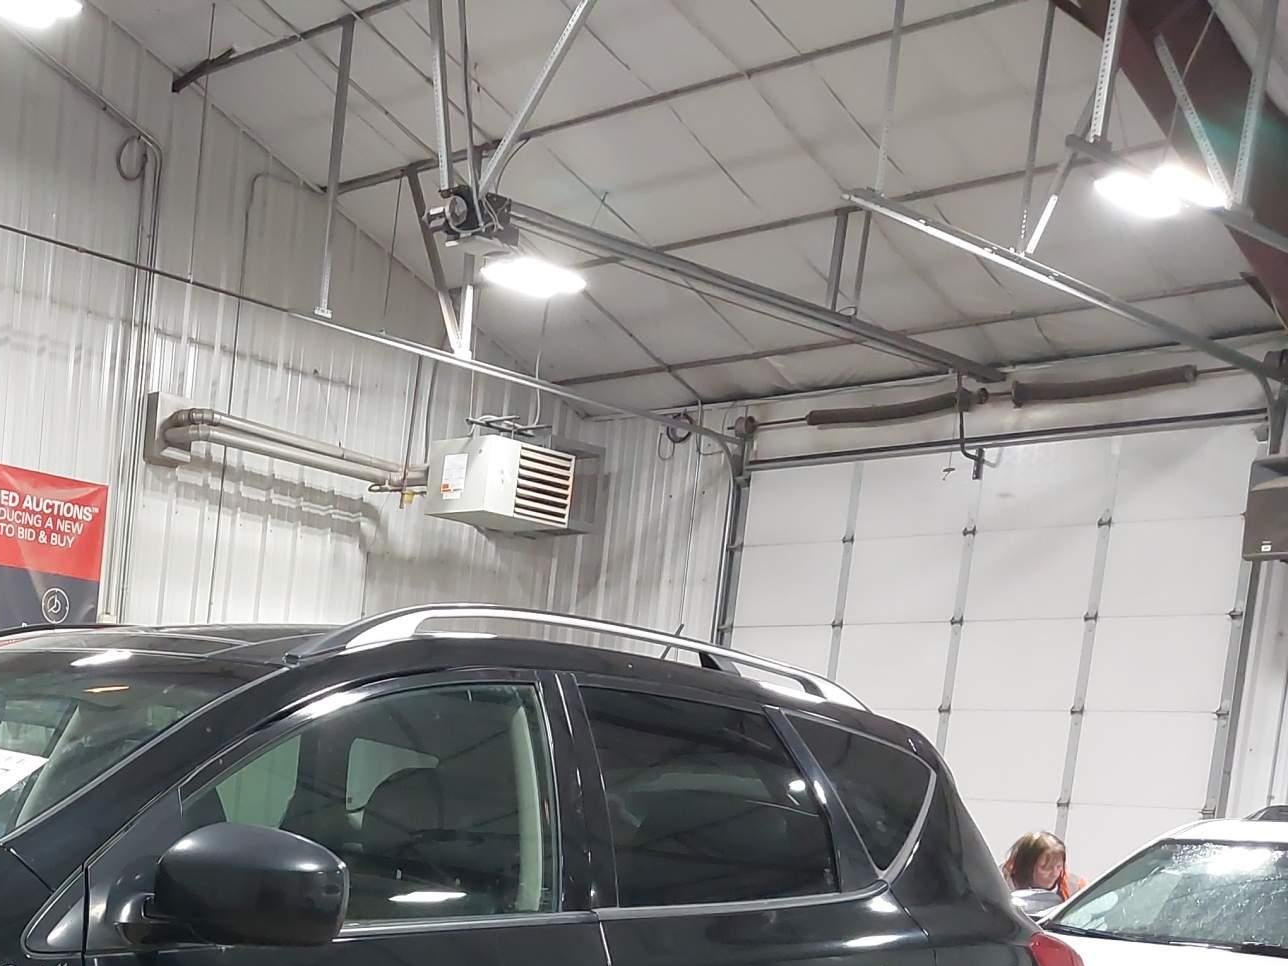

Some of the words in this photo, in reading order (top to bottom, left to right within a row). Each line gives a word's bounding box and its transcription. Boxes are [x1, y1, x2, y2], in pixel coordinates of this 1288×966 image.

[17, 526, 37, 542] BID
[38, 531, 48, 545] &
[50, 532, 76, 549] BUY
[44, 519, 54, 531] A
[56, 520, 84, 536] NEW
